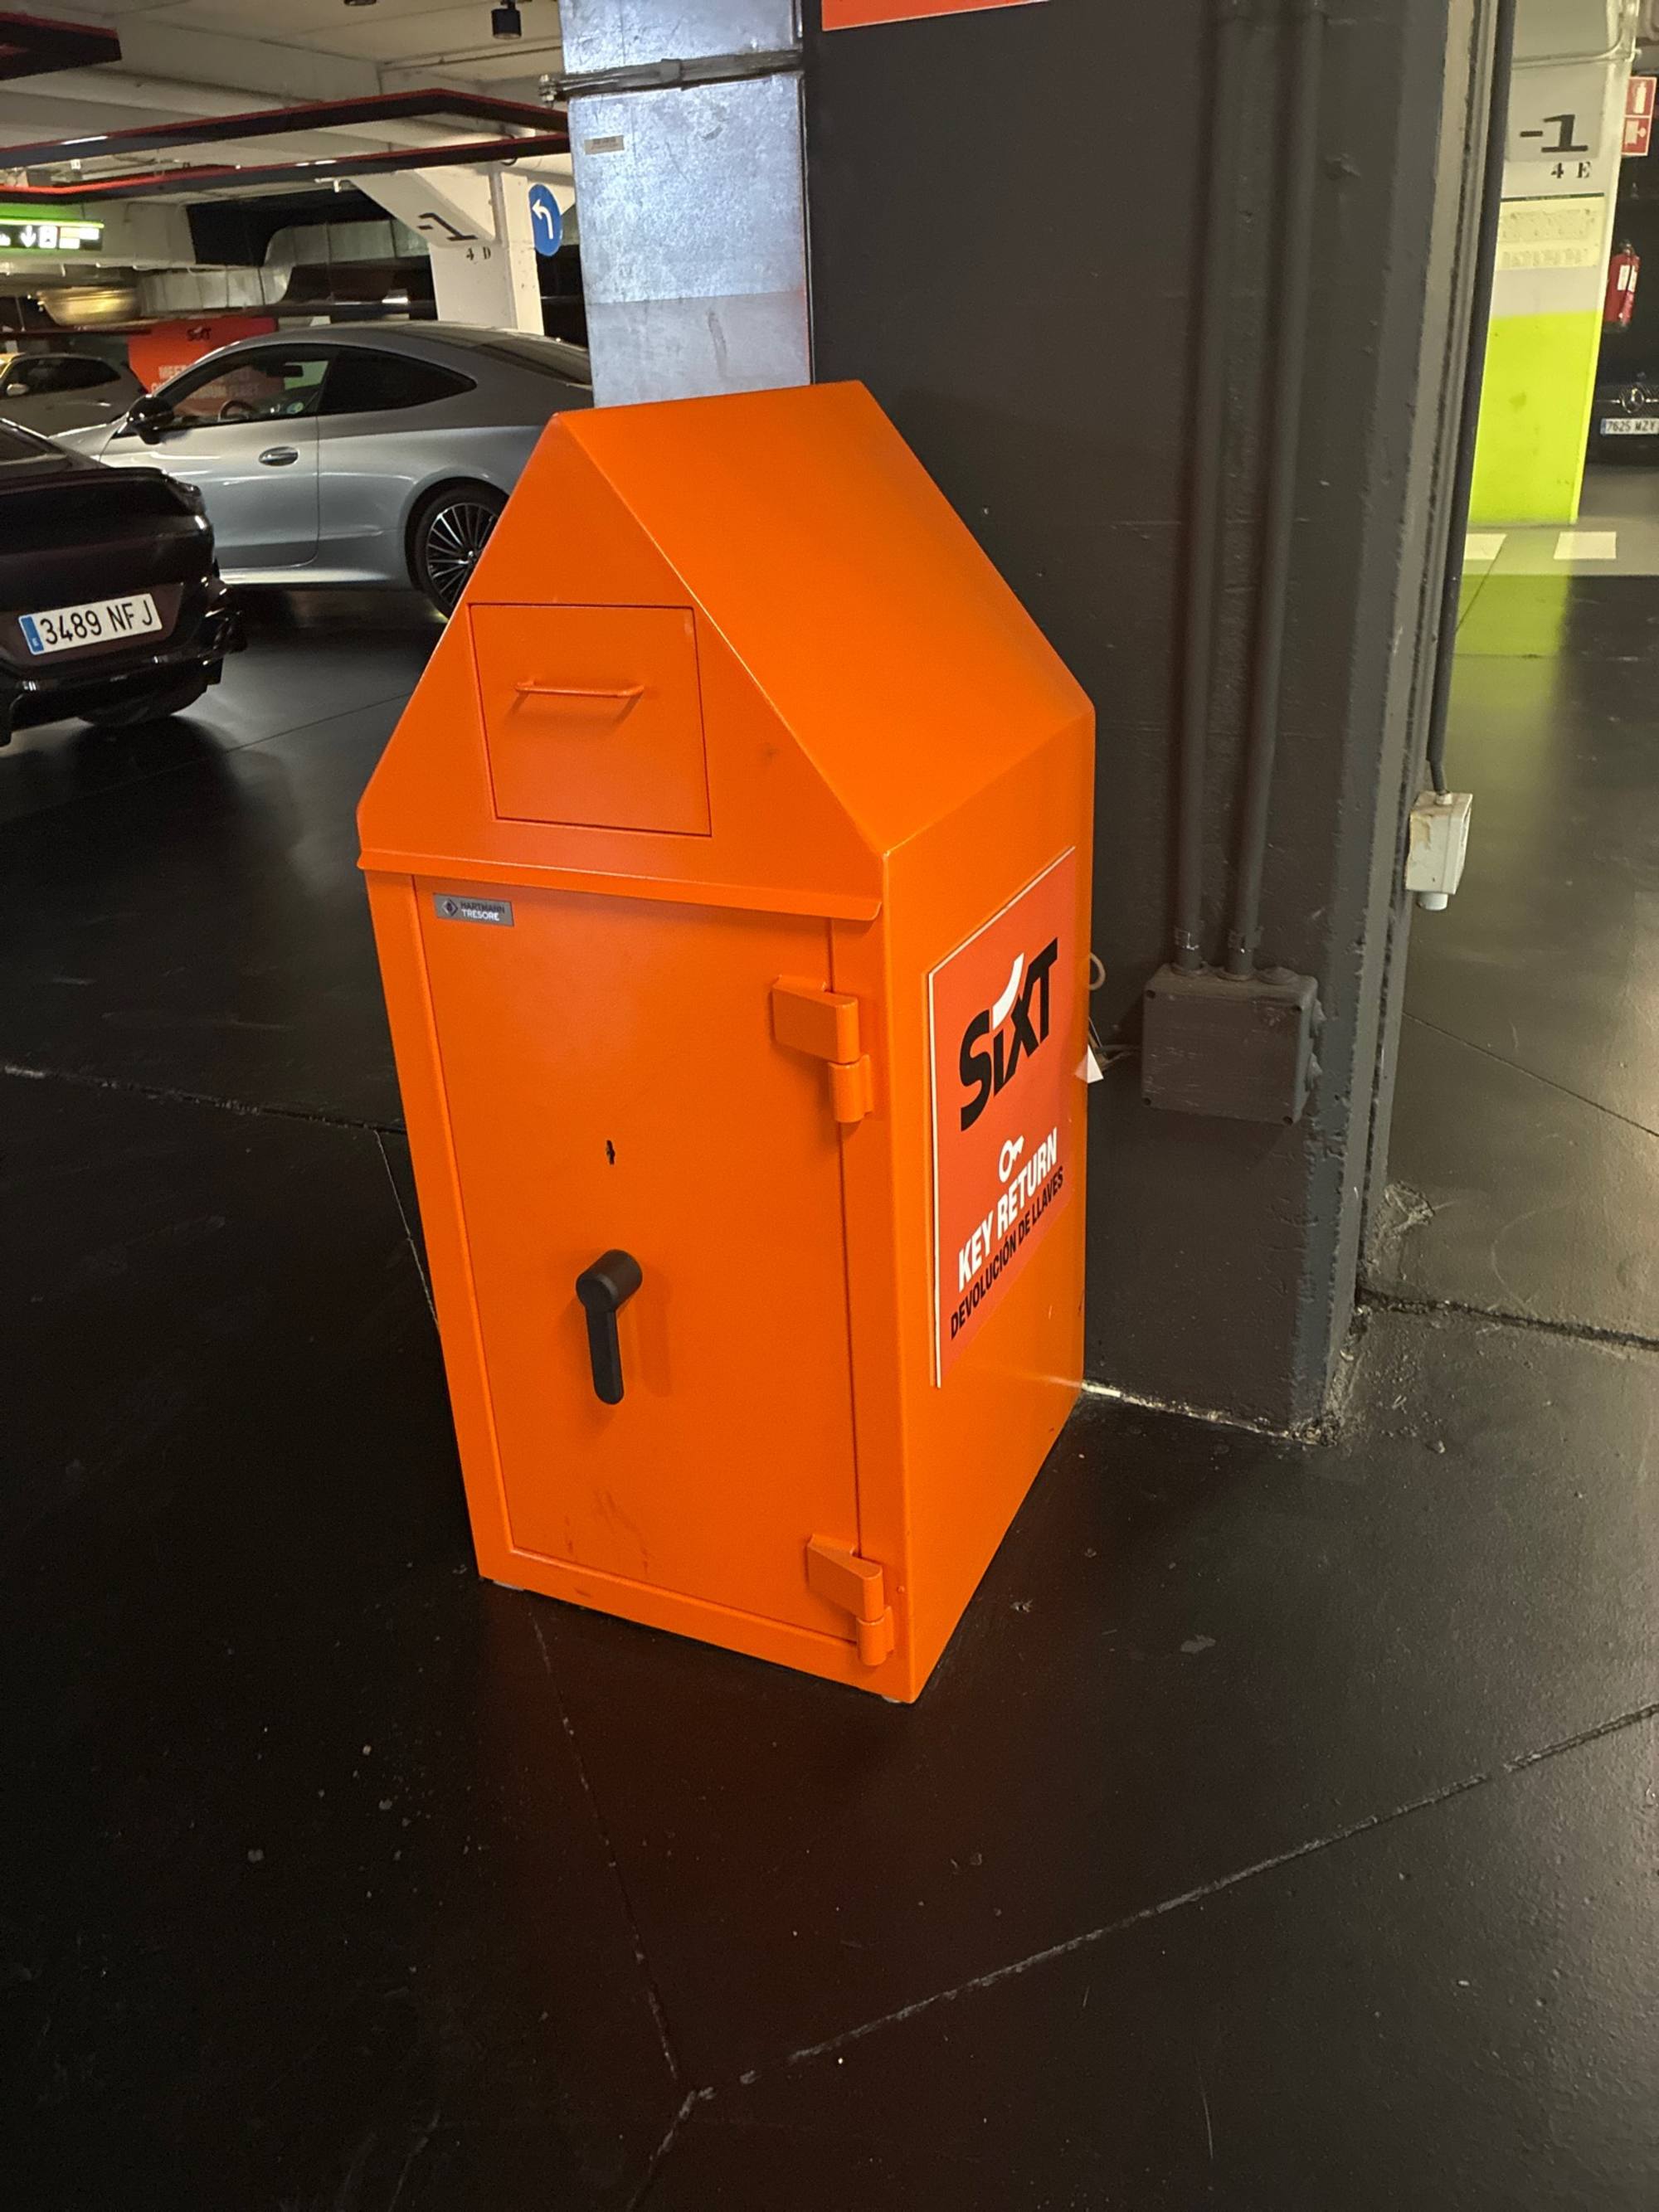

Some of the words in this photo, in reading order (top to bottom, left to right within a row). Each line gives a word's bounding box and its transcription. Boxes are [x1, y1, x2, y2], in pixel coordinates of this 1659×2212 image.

[1520, 114, 1588, 153] -1
[1550, 163, 1564, 179] 4
[1577, 162, 1591, 179] E
[417, 212, 479, 242] -1
[40, 610, 102, 644] 3489
[106, 600, 154, 632] NFJ
[461, 908, 500, 921] TRESORE
[958, 1210, 994, 1294] KEY
[997, 1126, 1058, 1240] RETURN
[951, 1233, 1017, 1340] DEVOLUCIÓN
[1018, 1210, 1030, 1245] DE
[1032, 1165, 1064, 1227] LLAVES
